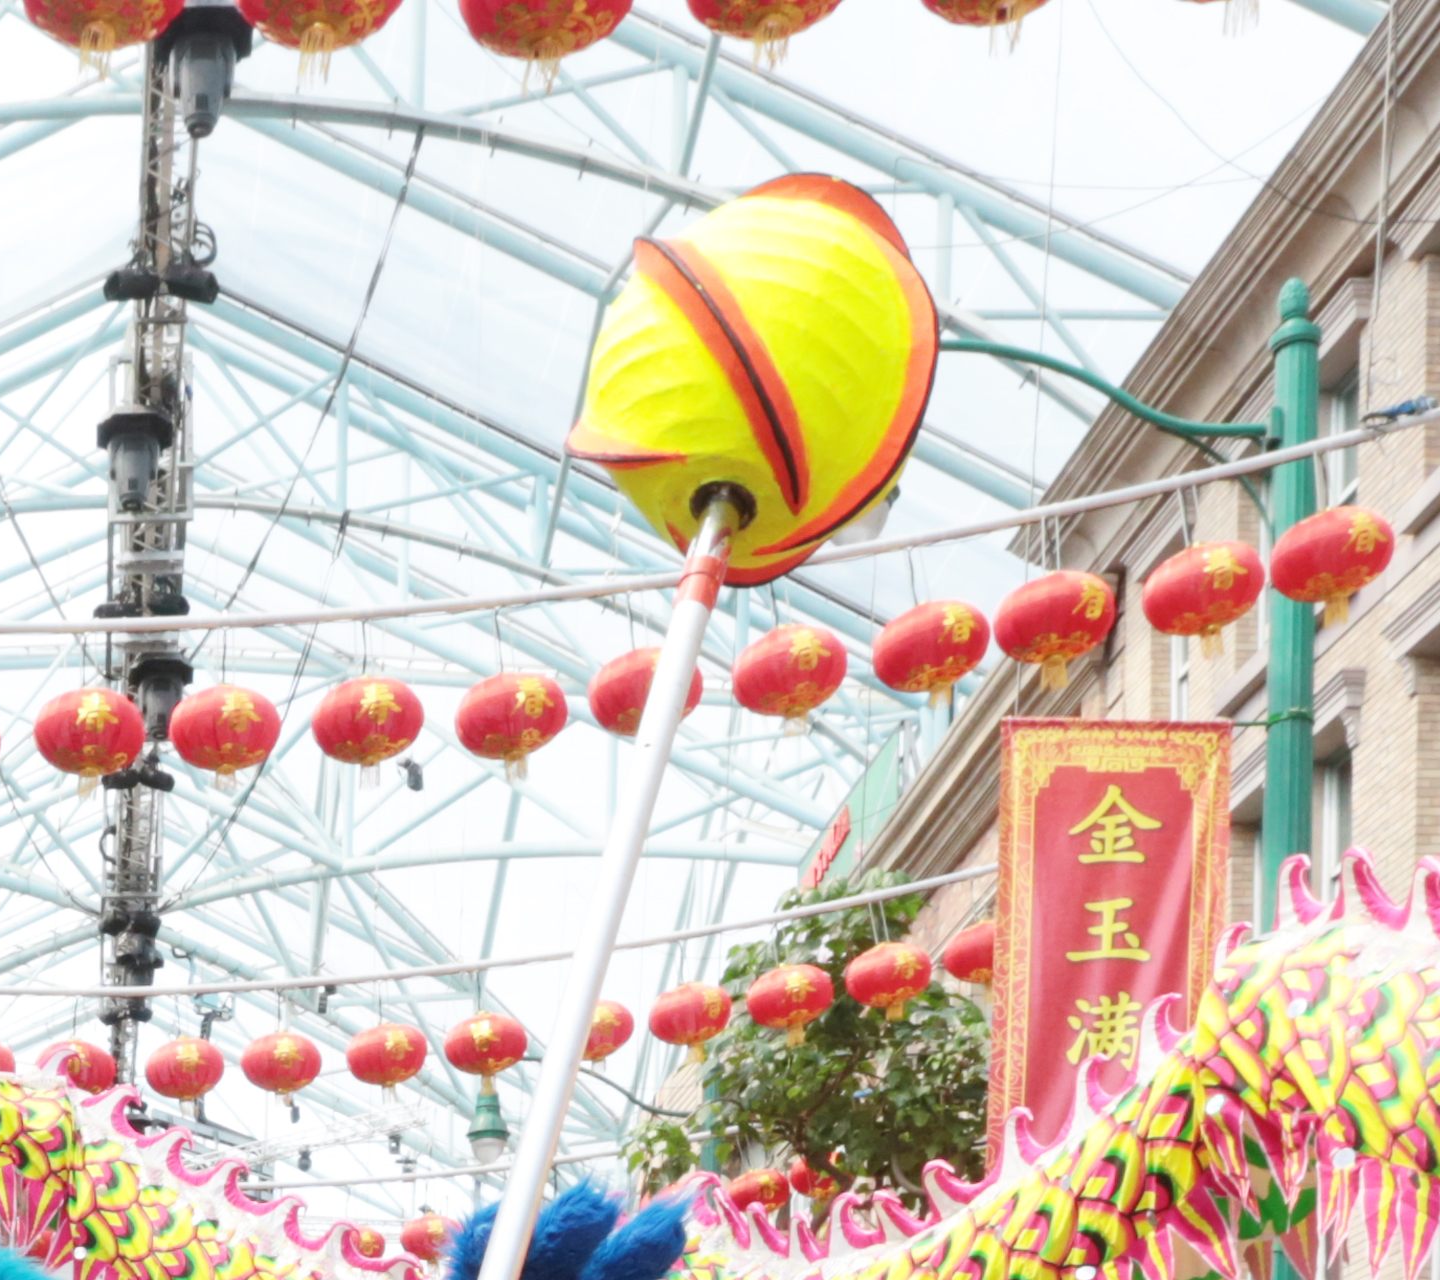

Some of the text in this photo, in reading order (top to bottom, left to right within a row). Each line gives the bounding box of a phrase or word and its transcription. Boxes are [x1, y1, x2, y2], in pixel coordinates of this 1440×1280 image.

[1342, 513, 1387, 554] 春
[789, 630, 831, 670] 春
[514, 678, 554, 717] 春
[1066, 784, 1162, 1071] 金玉满
